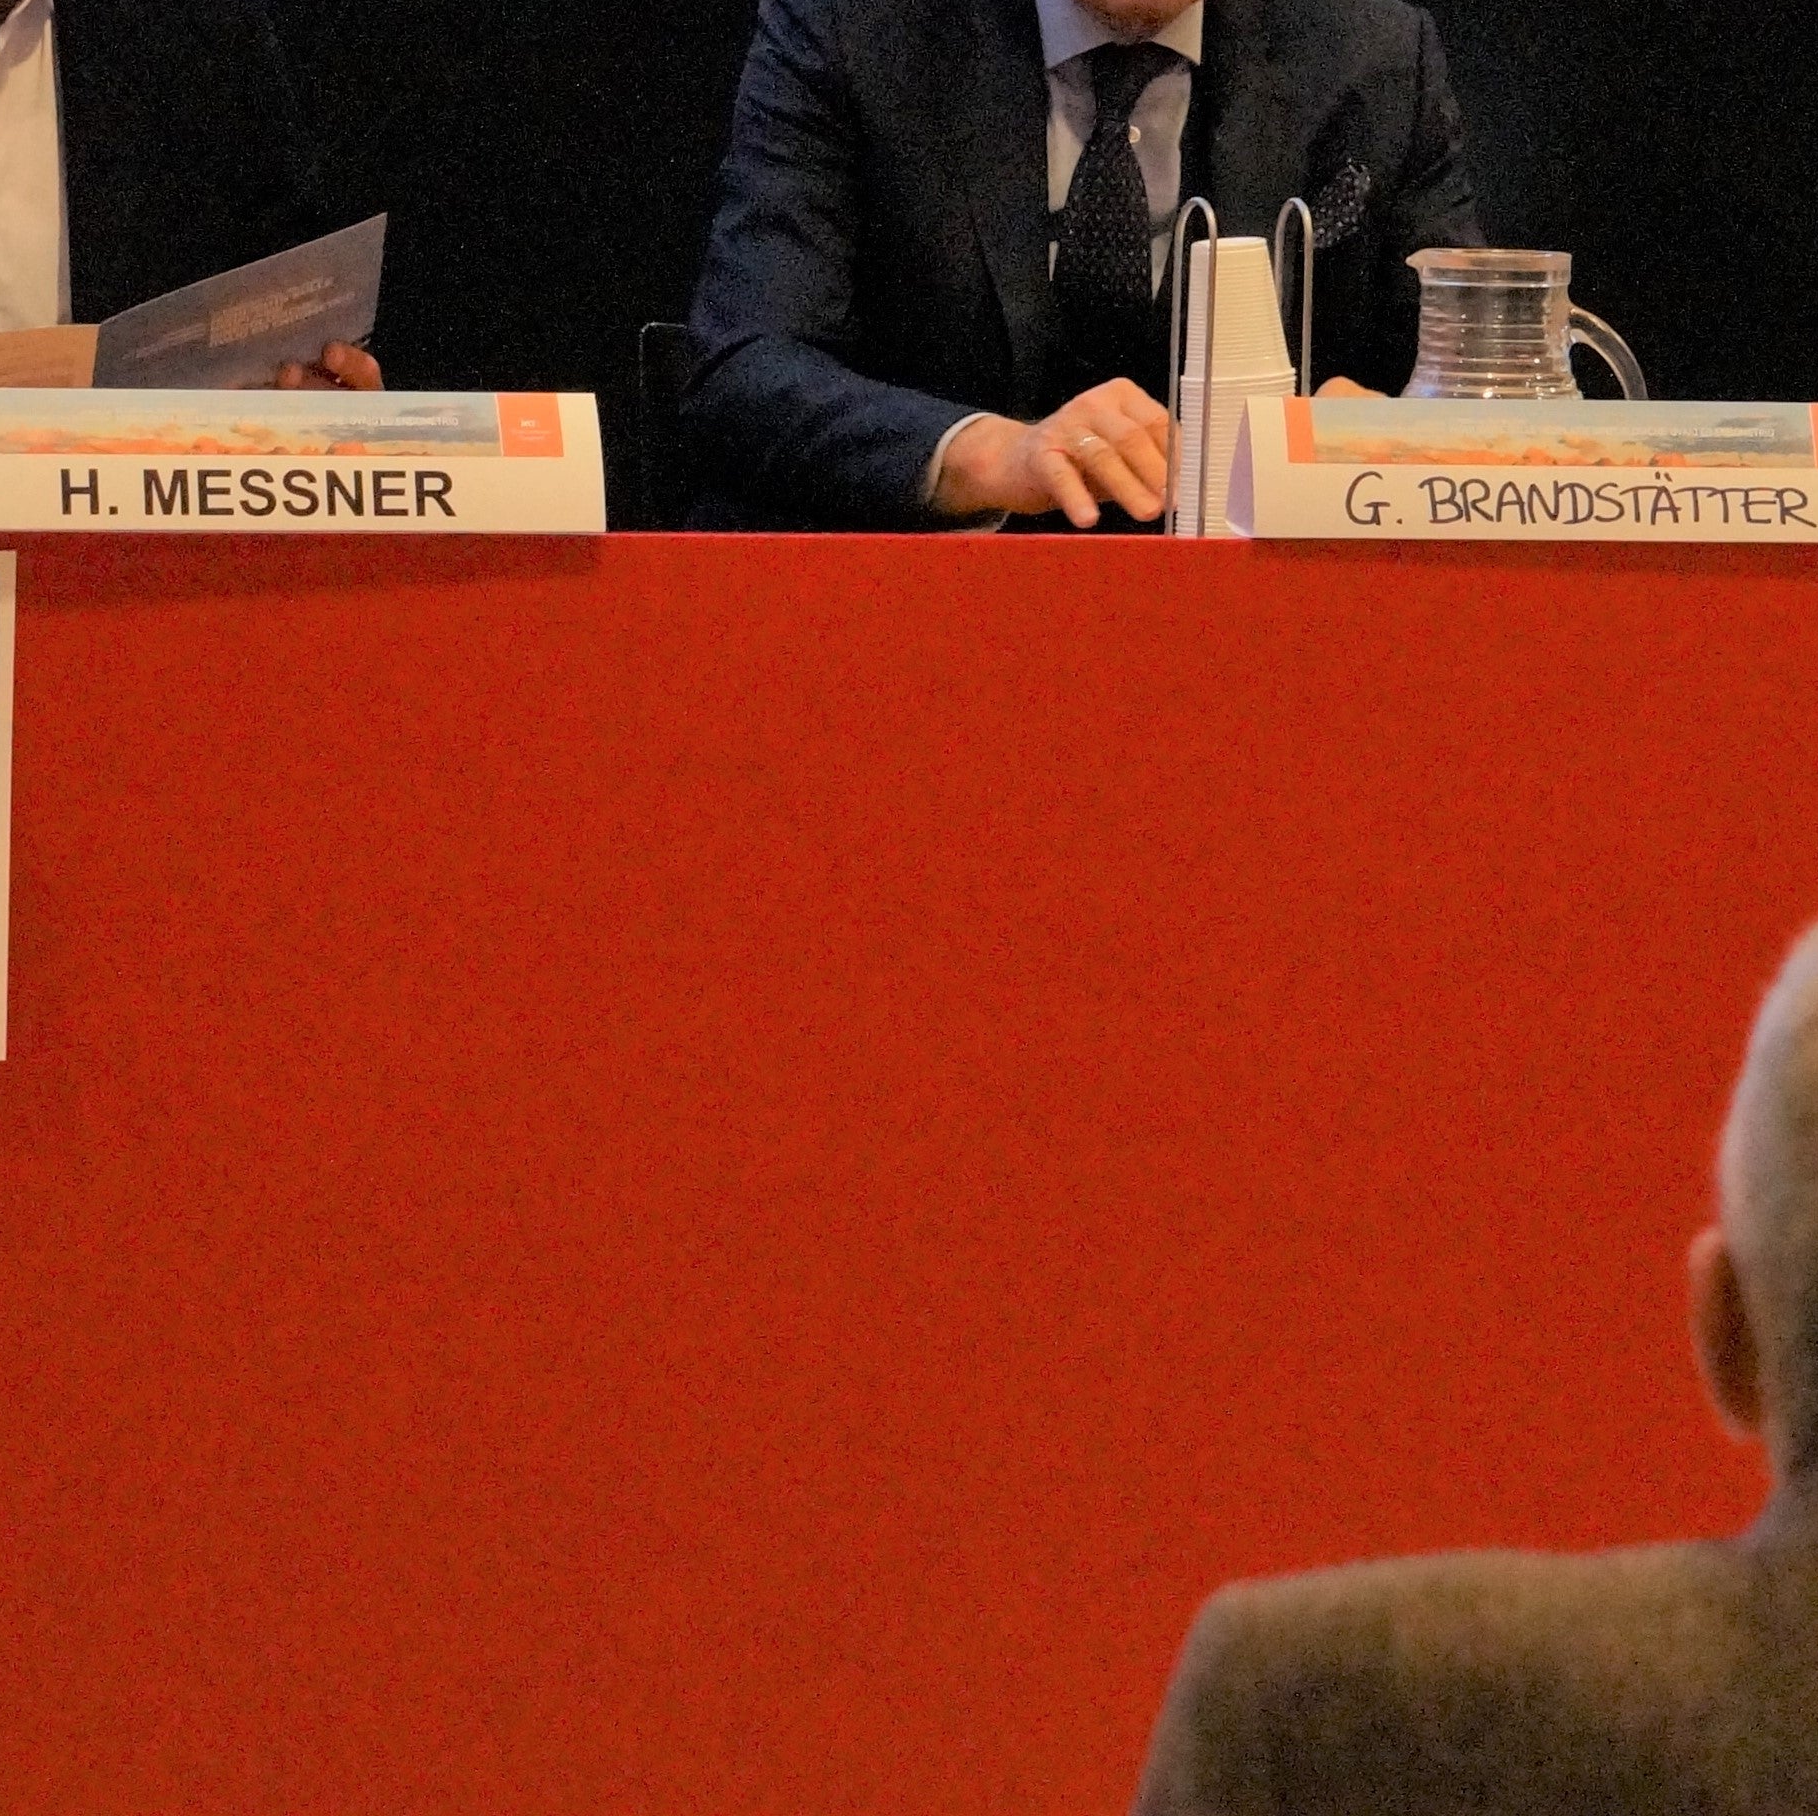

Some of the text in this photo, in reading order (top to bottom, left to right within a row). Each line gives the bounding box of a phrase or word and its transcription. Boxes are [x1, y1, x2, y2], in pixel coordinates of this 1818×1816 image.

[60, 468, 457, 518] H. MESSNER
[1345, 470, 1817, 527] G. BRANDSTÄTTER
